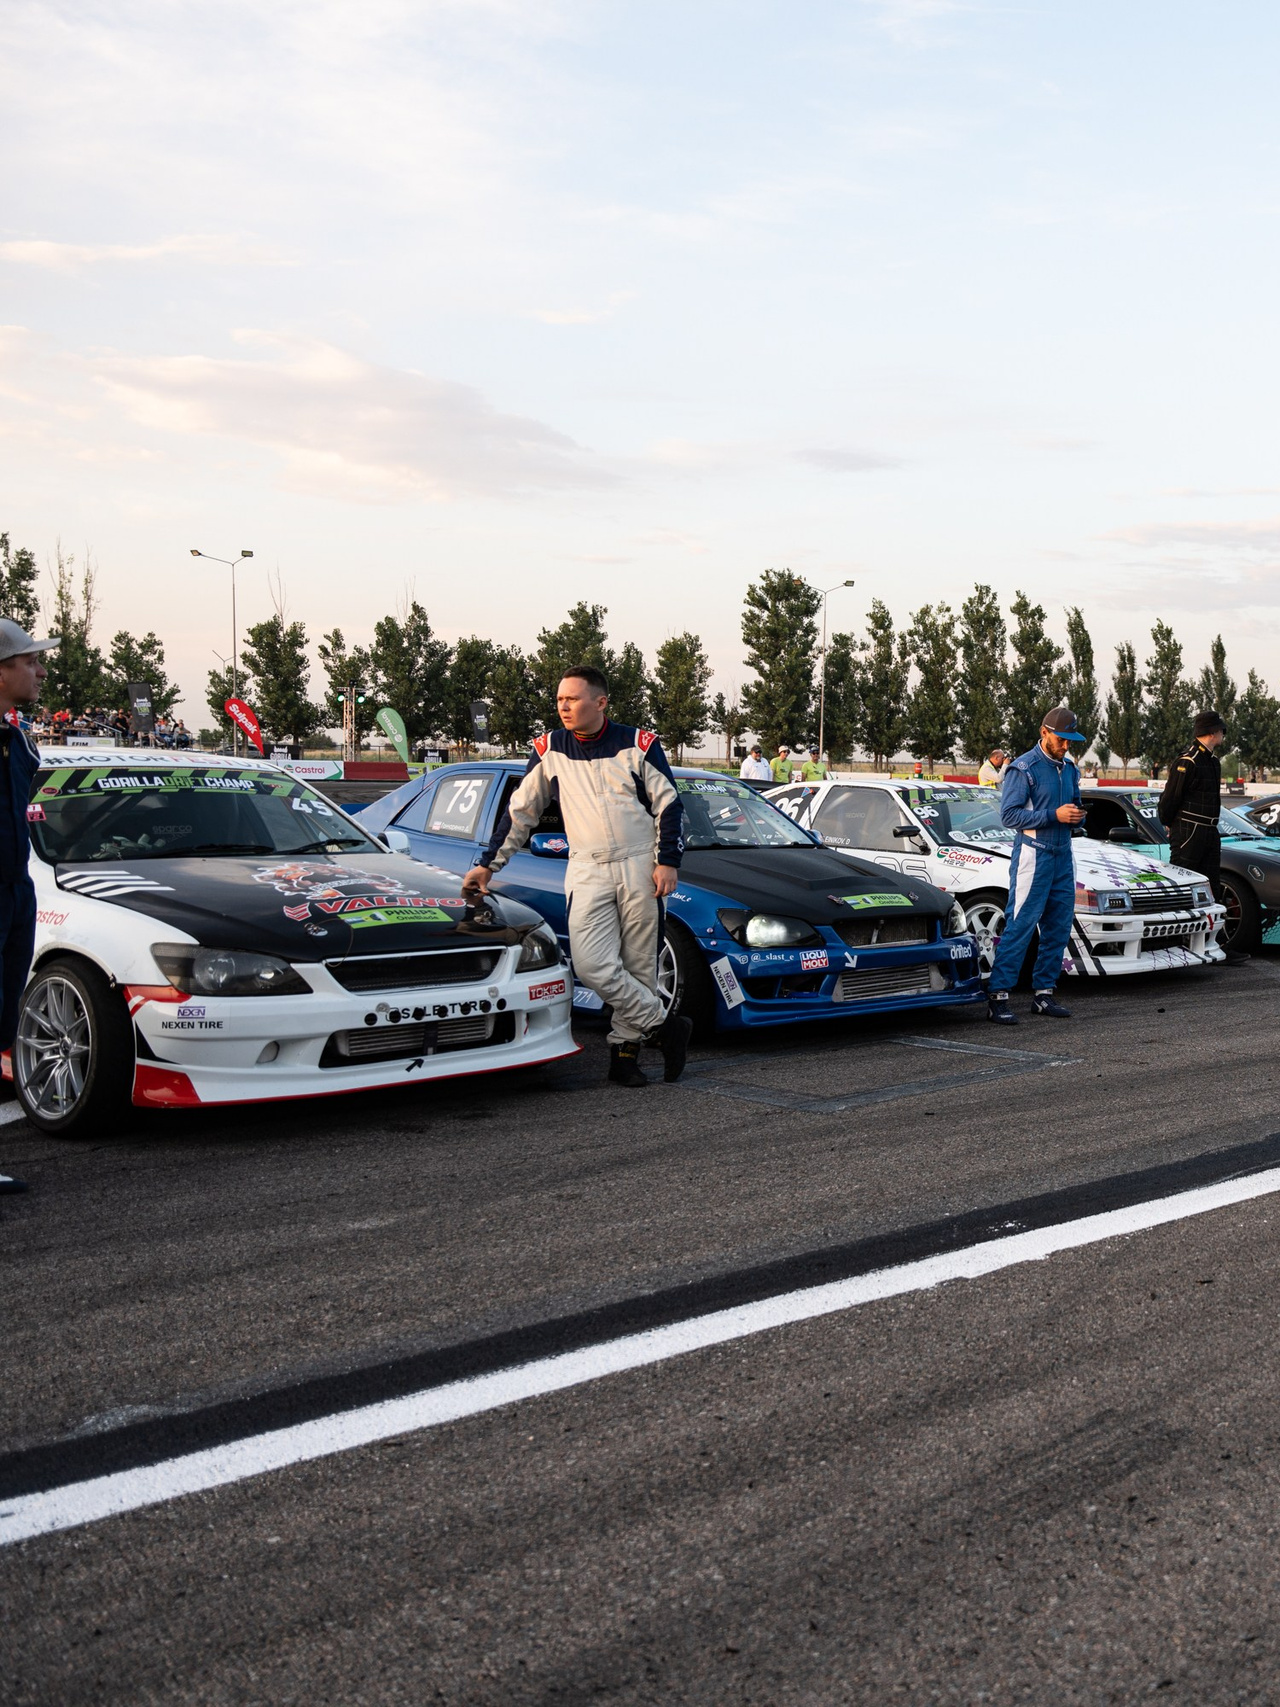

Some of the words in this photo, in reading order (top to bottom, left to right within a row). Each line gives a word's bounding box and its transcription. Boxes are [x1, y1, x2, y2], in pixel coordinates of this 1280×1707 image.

[228, 702, 257, 735] Sulpak
[295, 766, 325, 774] Castrol
[446, 780, 483, 814] 75
[292, 797, 333, 817] 45
[913, 806, 940, 819] 96
[1139, 807, 1158, 819] 07
[948, 851, 983, 865] Castrol
[315, 897, 467, 914] VALINO
[35, 909, 70, 926] astrol
[801, 950, 827, 960] LIQUI
[950, 944, 973, 960] drifted
[802, 959, 827, 969] MOLY
[713, 965, 727, 989] NEXEN
[723, 988, 734, 1005] TIRE
[177, 1008, 206, 1017] NEXEN
[161, 1021, 195, 1029] NEXEN
[198, 1021, 224, 1029] TIRE
